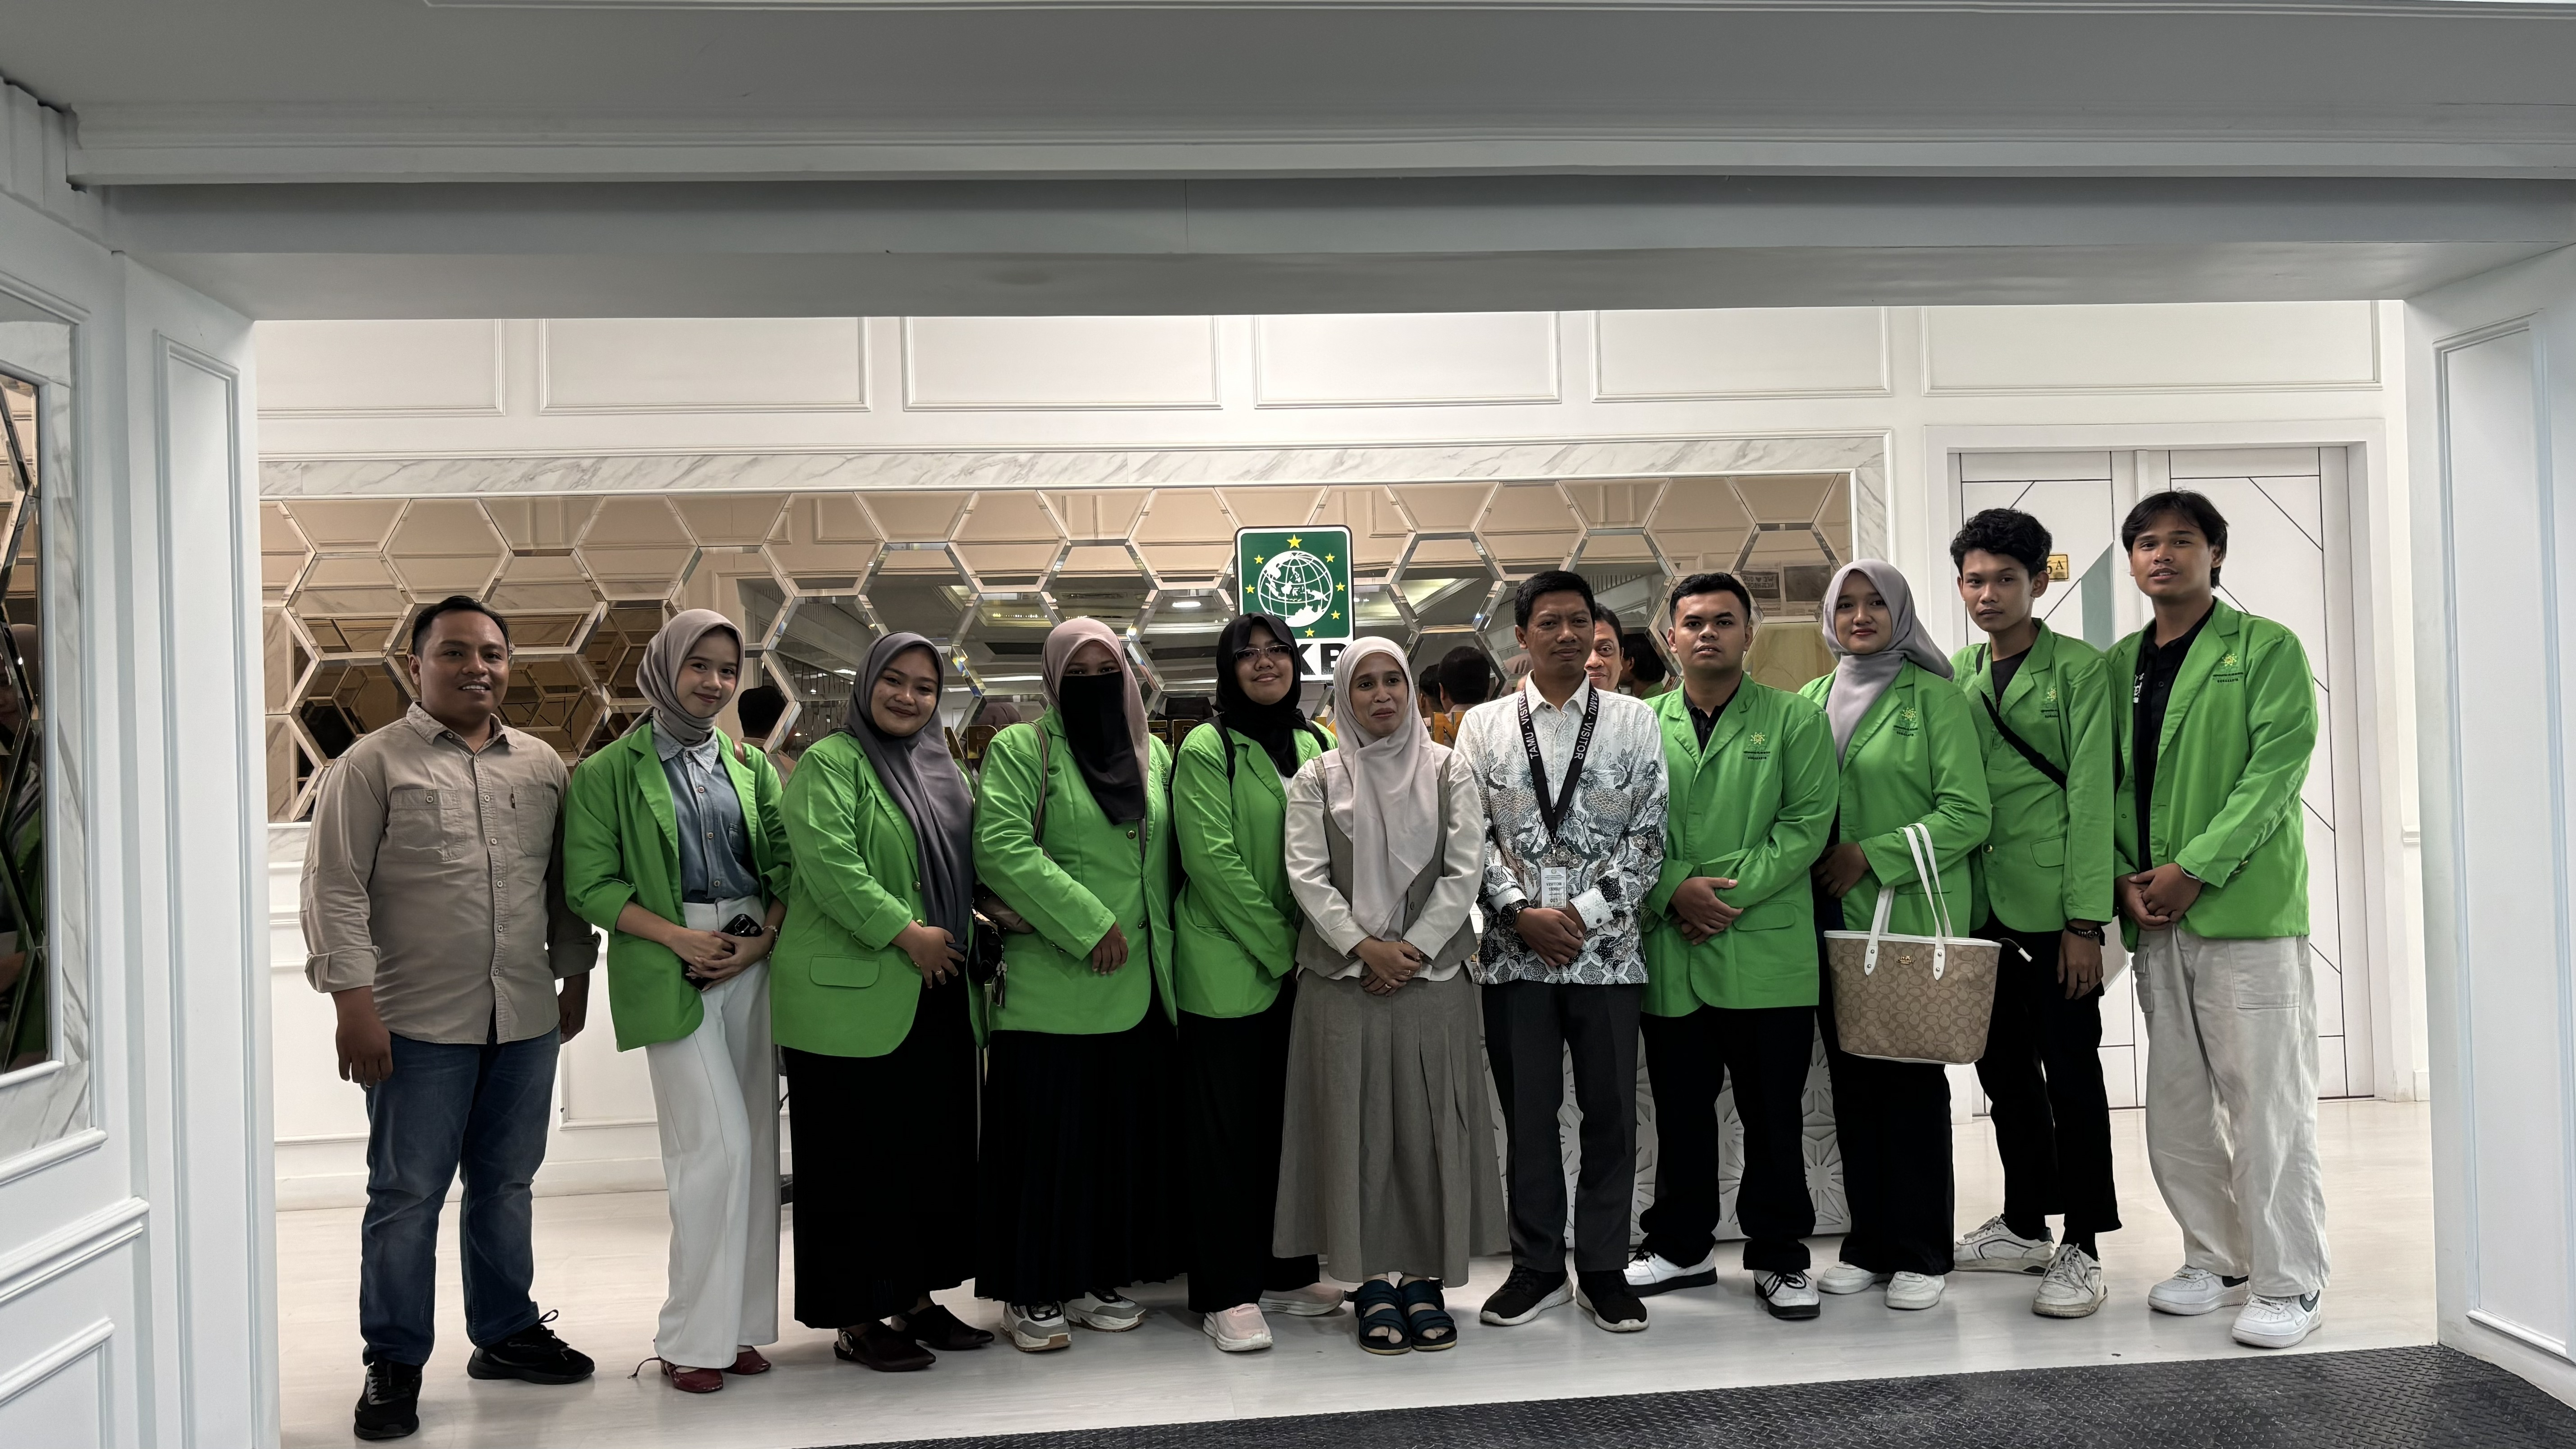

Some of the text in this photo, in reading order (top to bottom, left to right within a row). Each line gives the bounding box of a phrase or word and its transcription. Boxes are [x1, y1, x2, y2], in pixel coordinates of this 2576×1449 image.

[1298, 643, 1347, 675] KB
[1518, 690, 1530, 725] VISITOR
[1588, 691, 1598, 715] TAMU
[1525, 732, 1539, 759] TAMU
[1574, 722, 1594, 759] VISITOR
